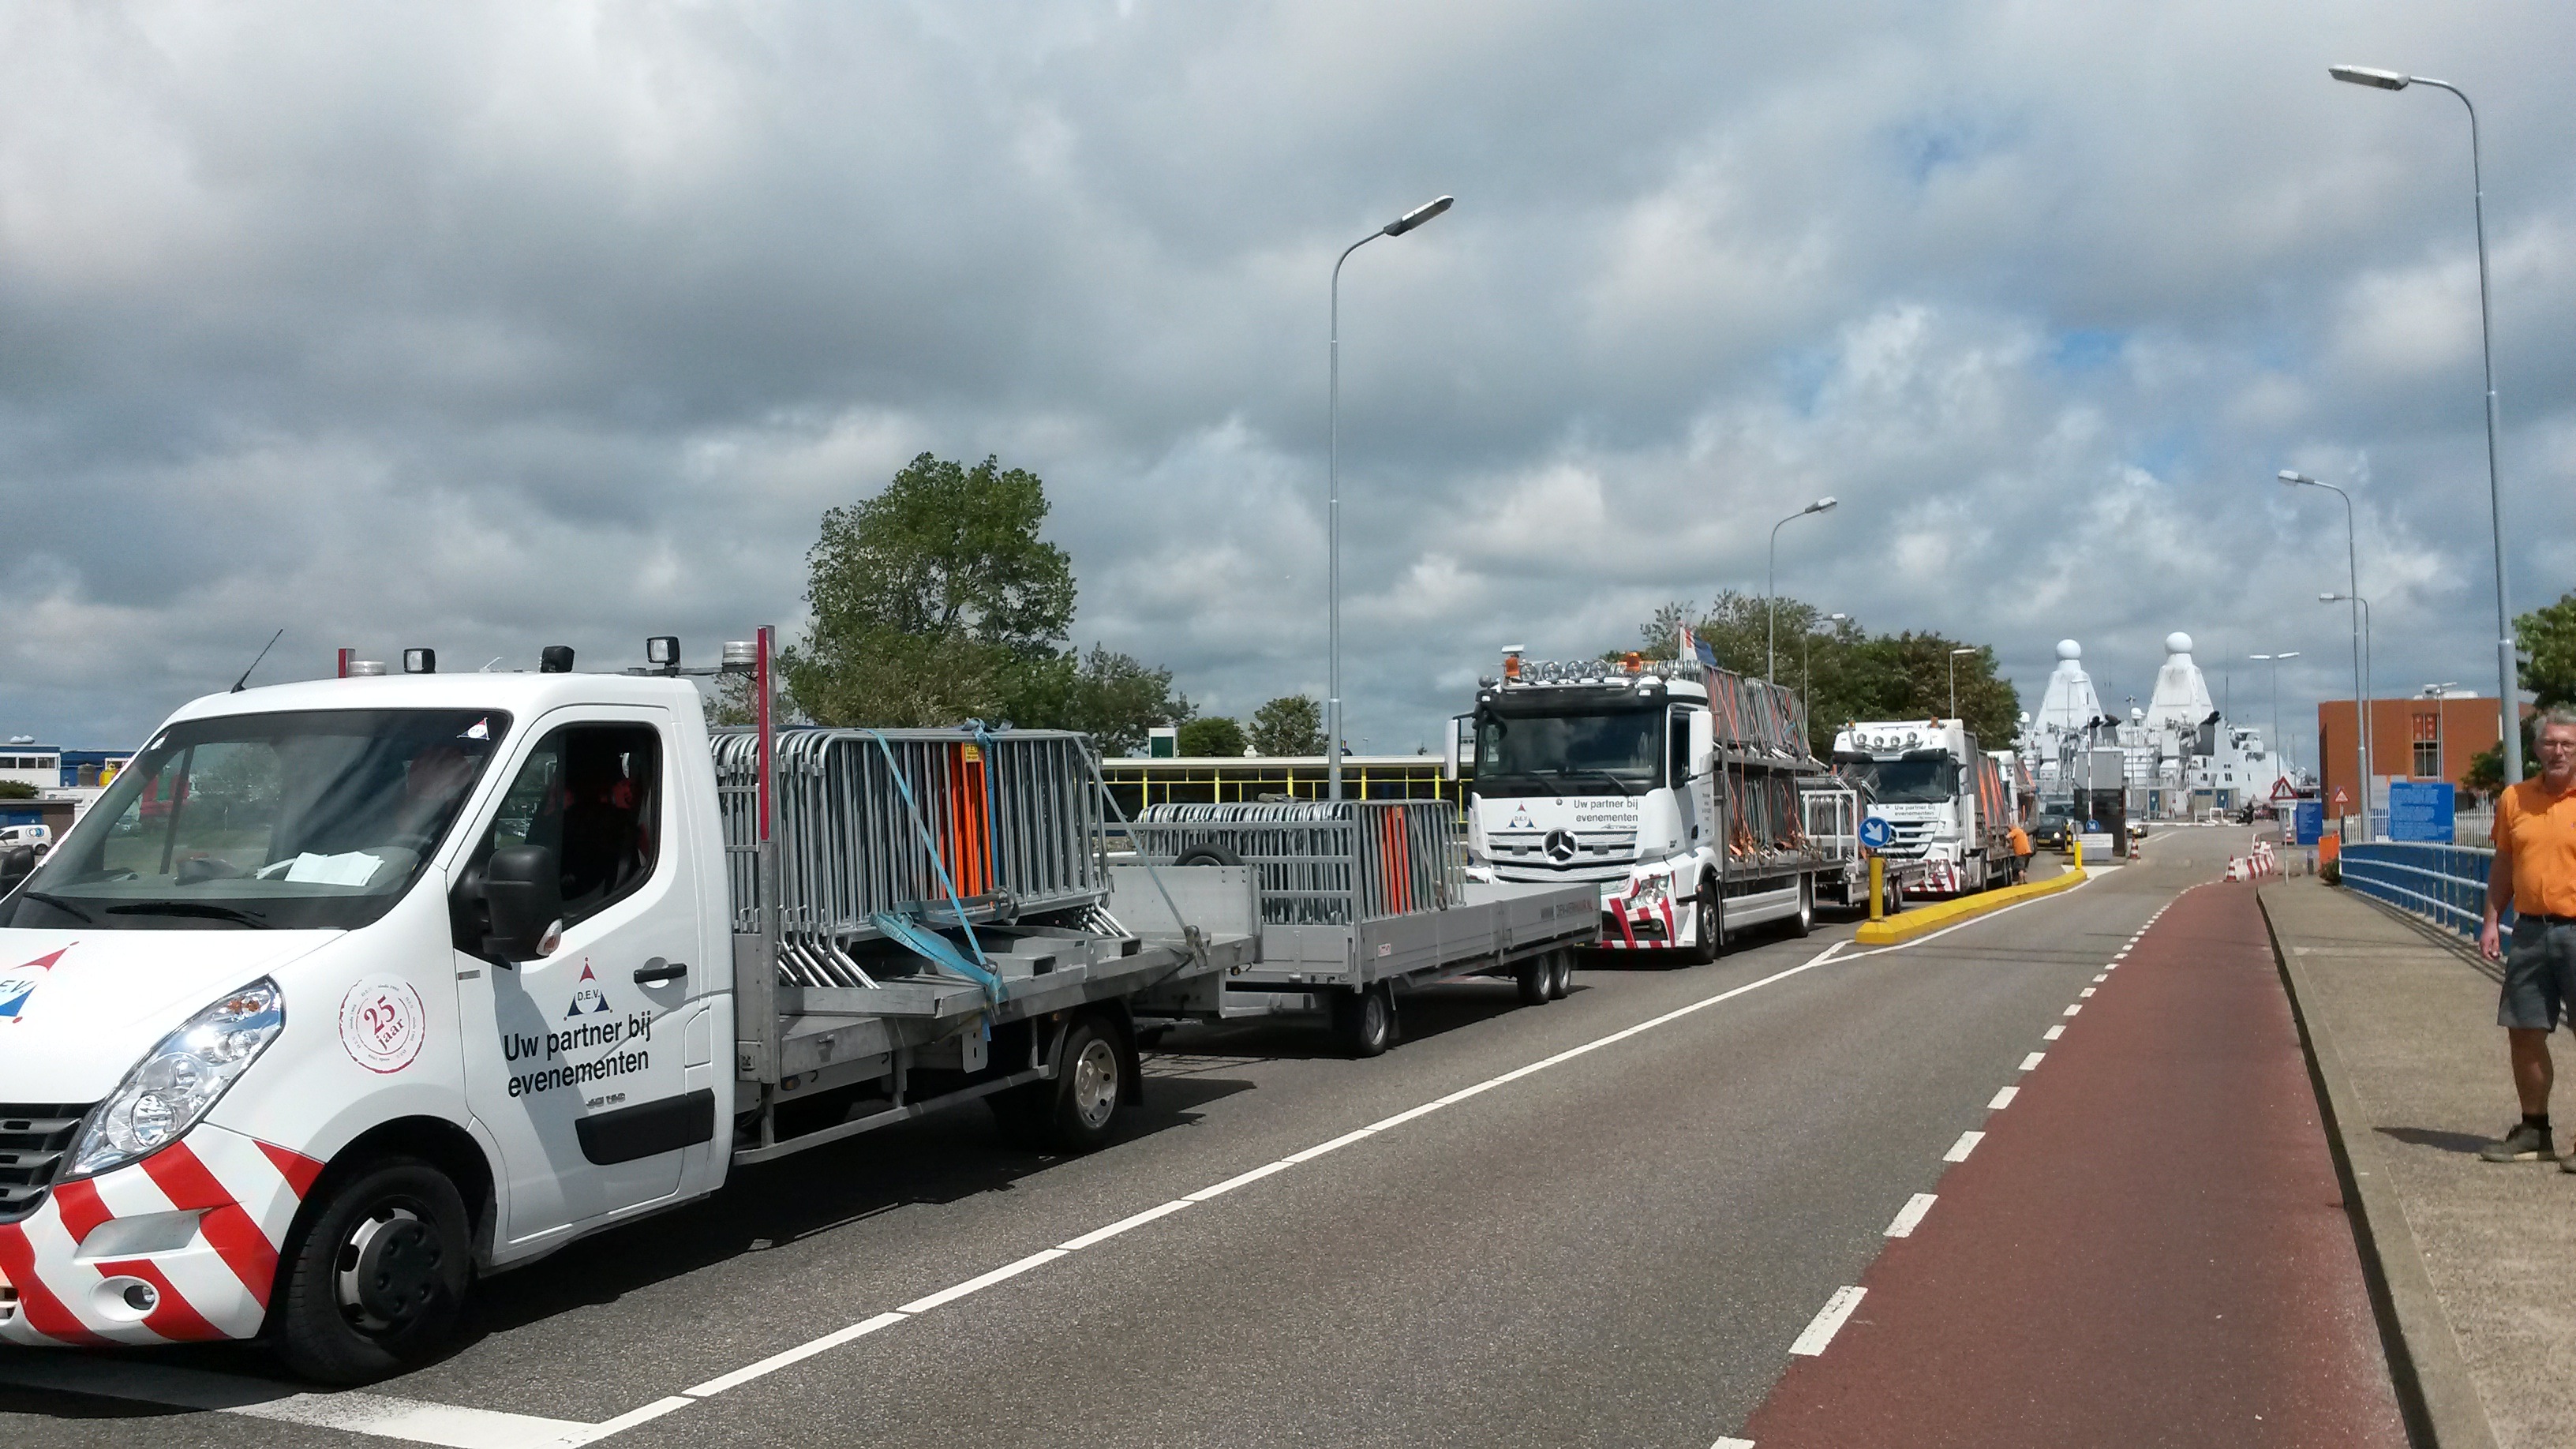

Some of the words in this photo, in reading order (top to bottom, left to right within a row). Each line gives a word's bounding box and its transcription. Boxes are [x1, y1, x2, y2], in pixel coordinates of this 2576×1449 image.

[1574, 799, 1587, 808] Uw
[1590, 799, 1623, 810] partner
[1627, 799, 1638, 810] bij
[1576, 813, 1638, 822] evenementen
[577, 989, 601, 1001] D.E.V.
[364, 994, 395, 1035] 25
[376, 1018, 405, 1051] jaar
[504, 1032, 539, 1061] Uw
[546, 1021, 623, 1061] partner
[628, 1010, 651, 1042] bij
[507, 1050, 649, 1098] evenementen
